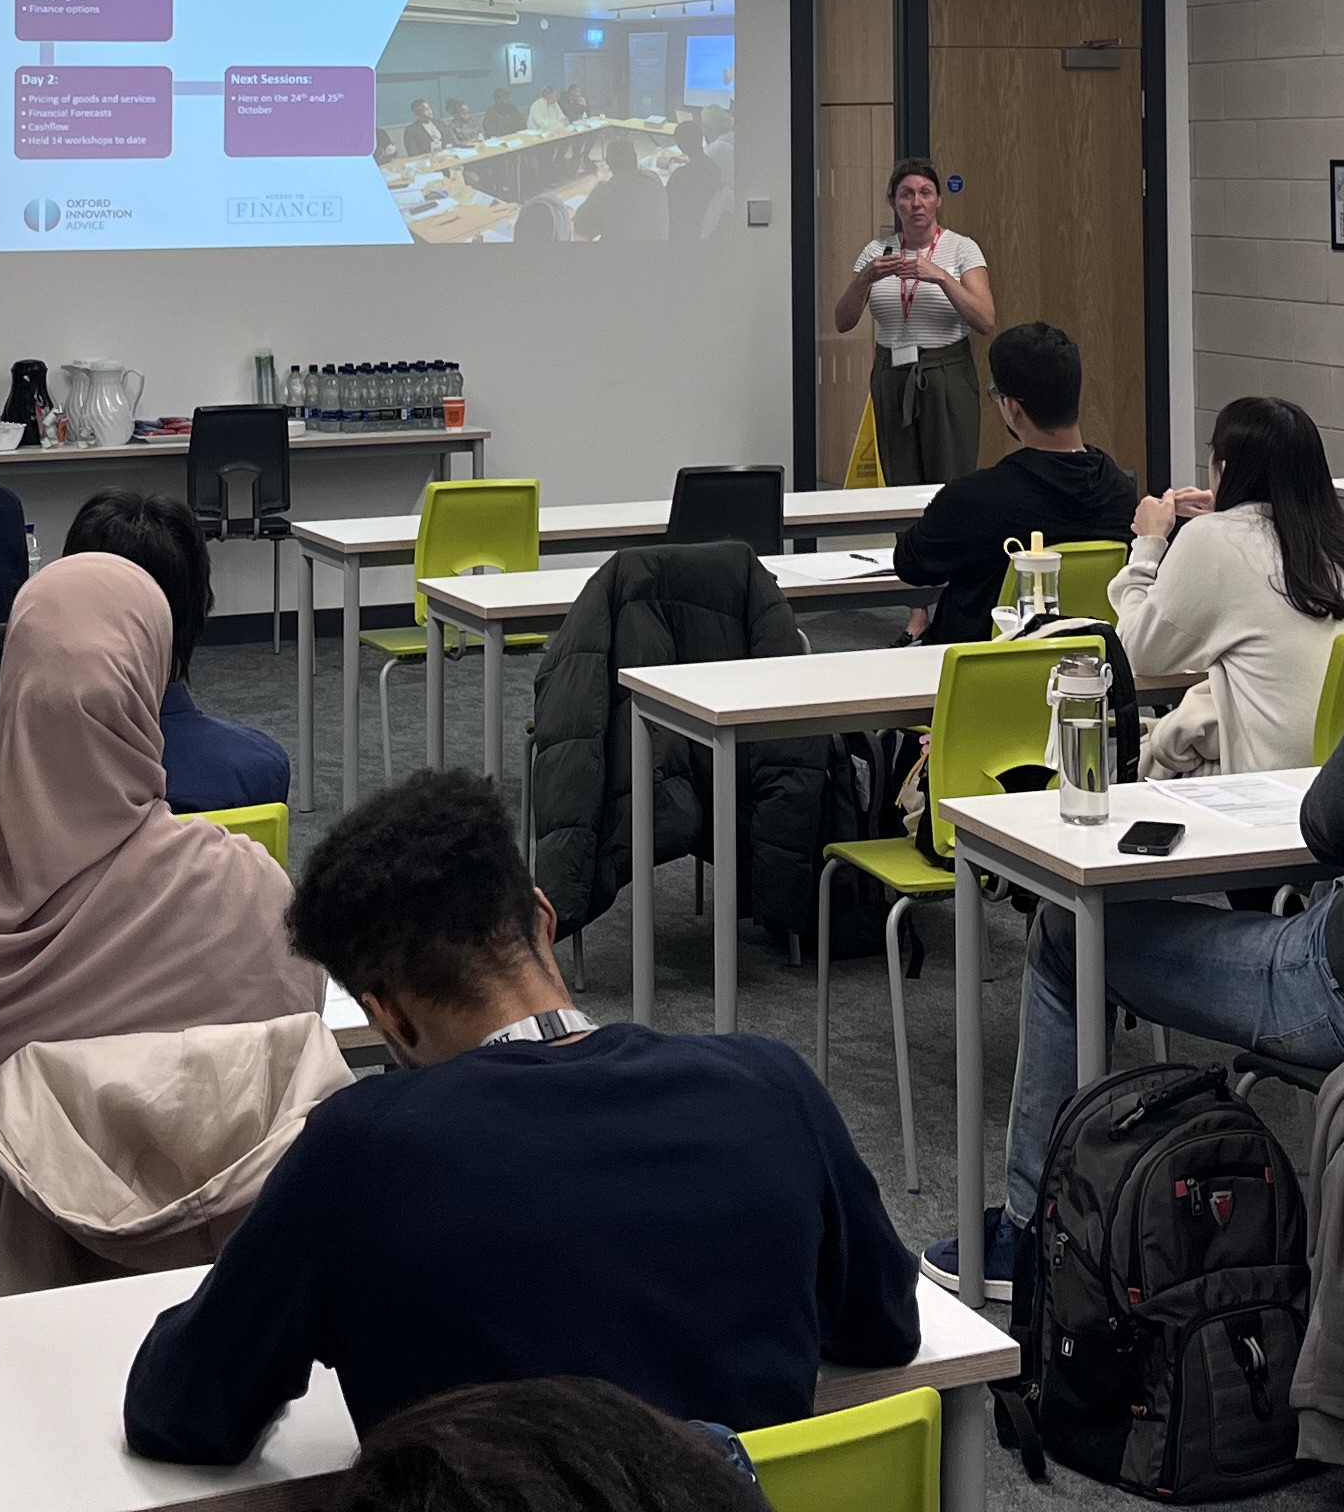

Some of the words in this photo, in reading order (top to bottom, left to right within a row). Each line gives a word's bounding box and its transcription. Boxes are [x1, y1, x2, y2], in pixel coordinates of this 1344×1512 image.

[29, 5, 64, 14] Finance
[65, 5, 100, 15] options
[21, 74, 44, 87] Day
[47, 74, 59, 85] 2:
[230, 74, 258, 85] Next
[260, 74, 313, 85] Sessions:
[28, 95, 59, 105] Pricing
[61, 94, 71, 103] of
[72, 94, 100, 106] goods
[101, 95, 119, 103] and
[120, 95, 156, 104] services
[238, 94, 259, 103] Here
[260, 95, 273, 103] on
[274, 93, 289, 103] the
[309, 93, 326, 103] and
[28, 109, 68, 118] Financial
[70, 109, 112, 118] Forecasts
[237, 106, 273, 115] October
[28, 122, 69, 132] Cashflow
[28, 136, 49, 145] Held
[64, 136, 113, 147] workshops
[115, 136, 125, 145] to
[126, 136, 147, 145] date
[66, 199, 111, 209] OXFORD
[65, 209, 133, 219] INNOVATION
[236, 201, 334, 219] FINANCE
[65, 220, 105, 230] ADVICE
